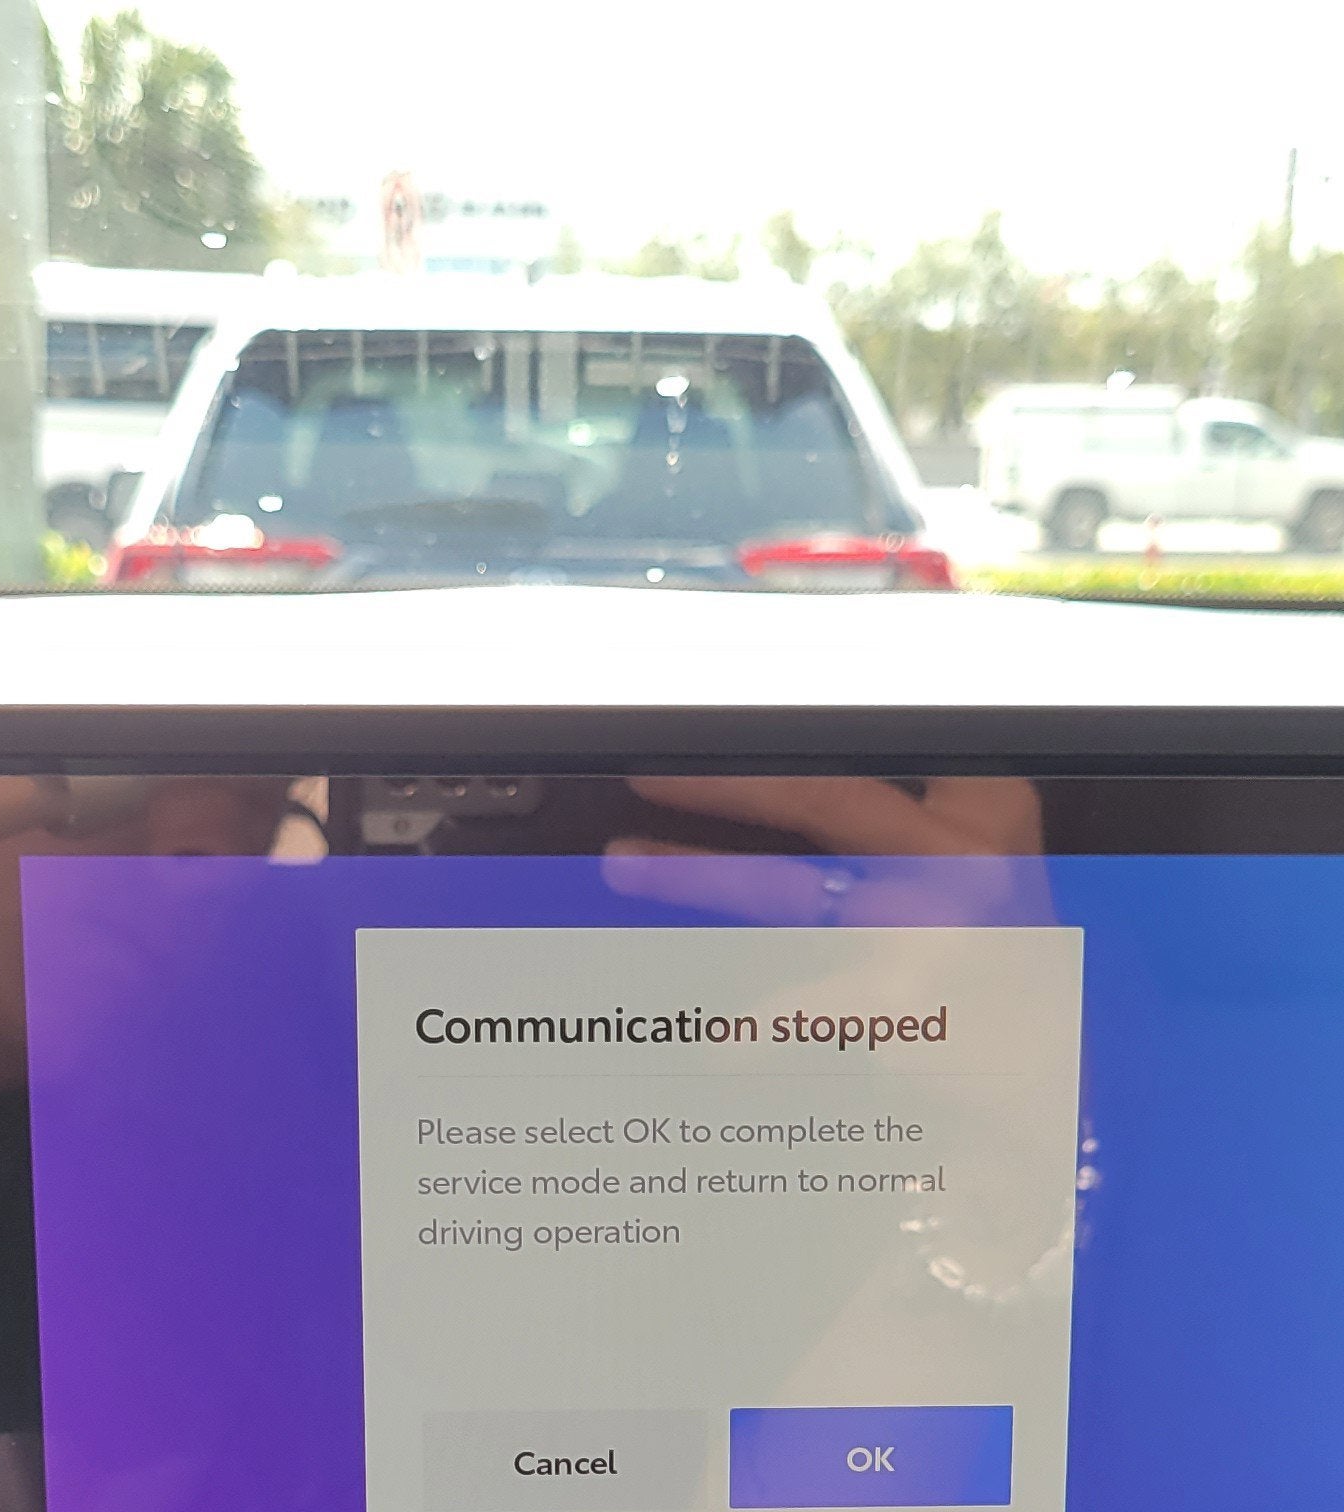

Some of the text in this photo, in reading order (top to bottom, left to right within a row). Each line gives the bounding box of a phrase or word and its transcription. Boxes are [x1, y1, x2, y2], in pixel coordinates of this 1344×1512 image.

[414, 1006, 948, 1051] Communication stopped
[417, 1115, 924, 1150] Please select OK to complete the
[417, 1165, 947, 1197] service mode and return to normal
[418, 1218, 681, 1252] driving operation
[513, 1449, 619, 1477] Cancel
[846, 1446, 896, 1474] OK
